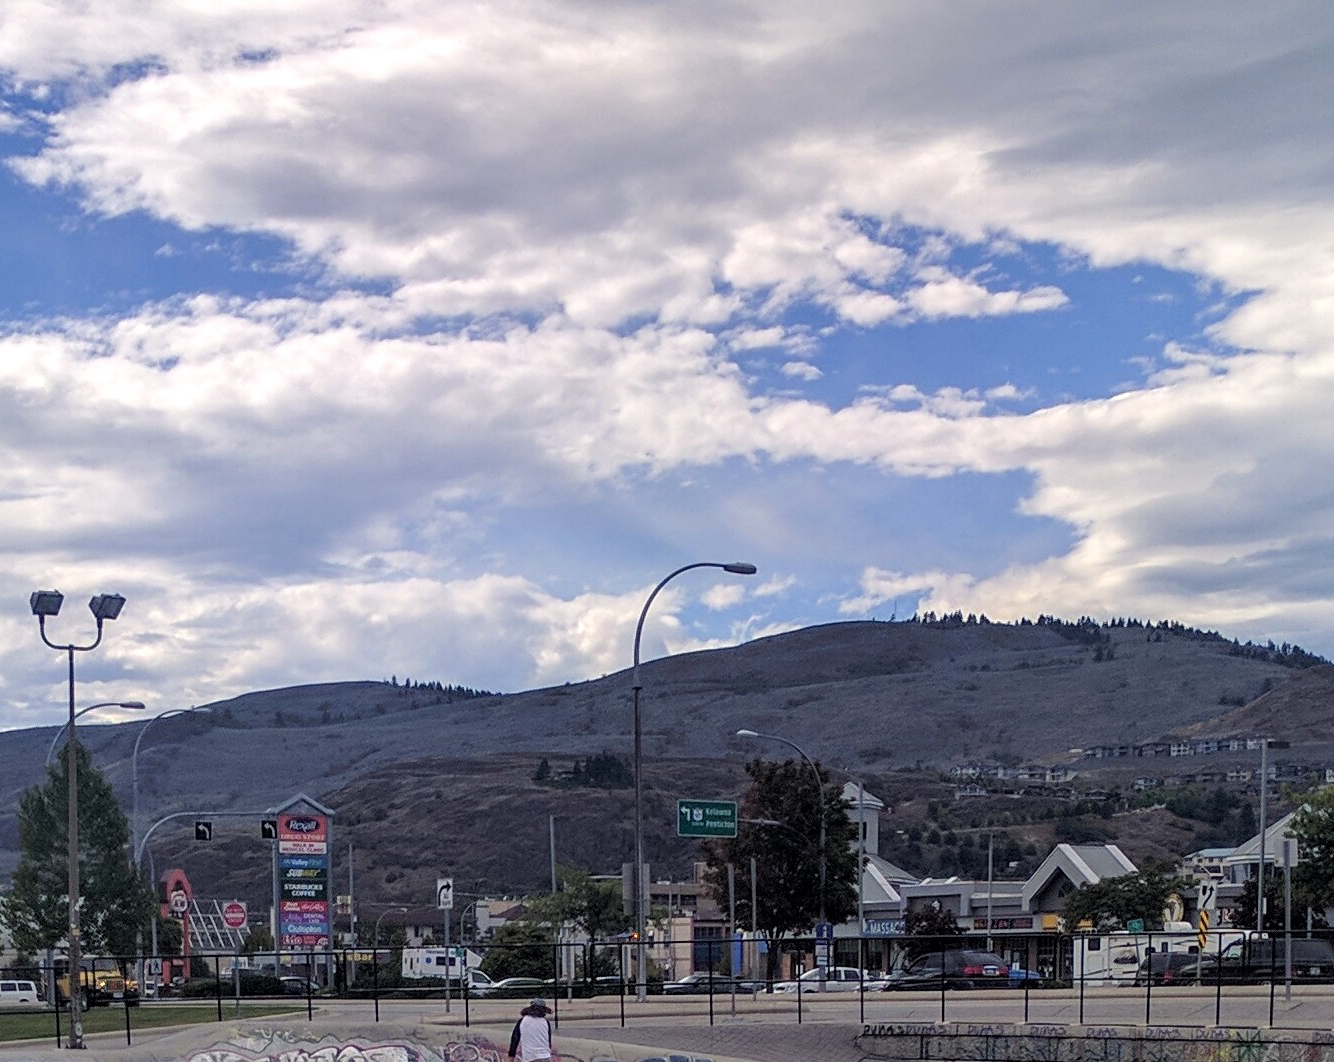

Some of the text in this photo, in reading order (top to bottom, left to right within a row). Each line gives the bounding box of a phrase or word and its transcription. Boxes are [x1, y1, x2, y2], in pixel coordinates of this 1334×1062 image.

[289, 820, 317, 832] Rexall
[291, 859, 308, 867] Valley
[287, 868, 320, 877] SUBWAY
